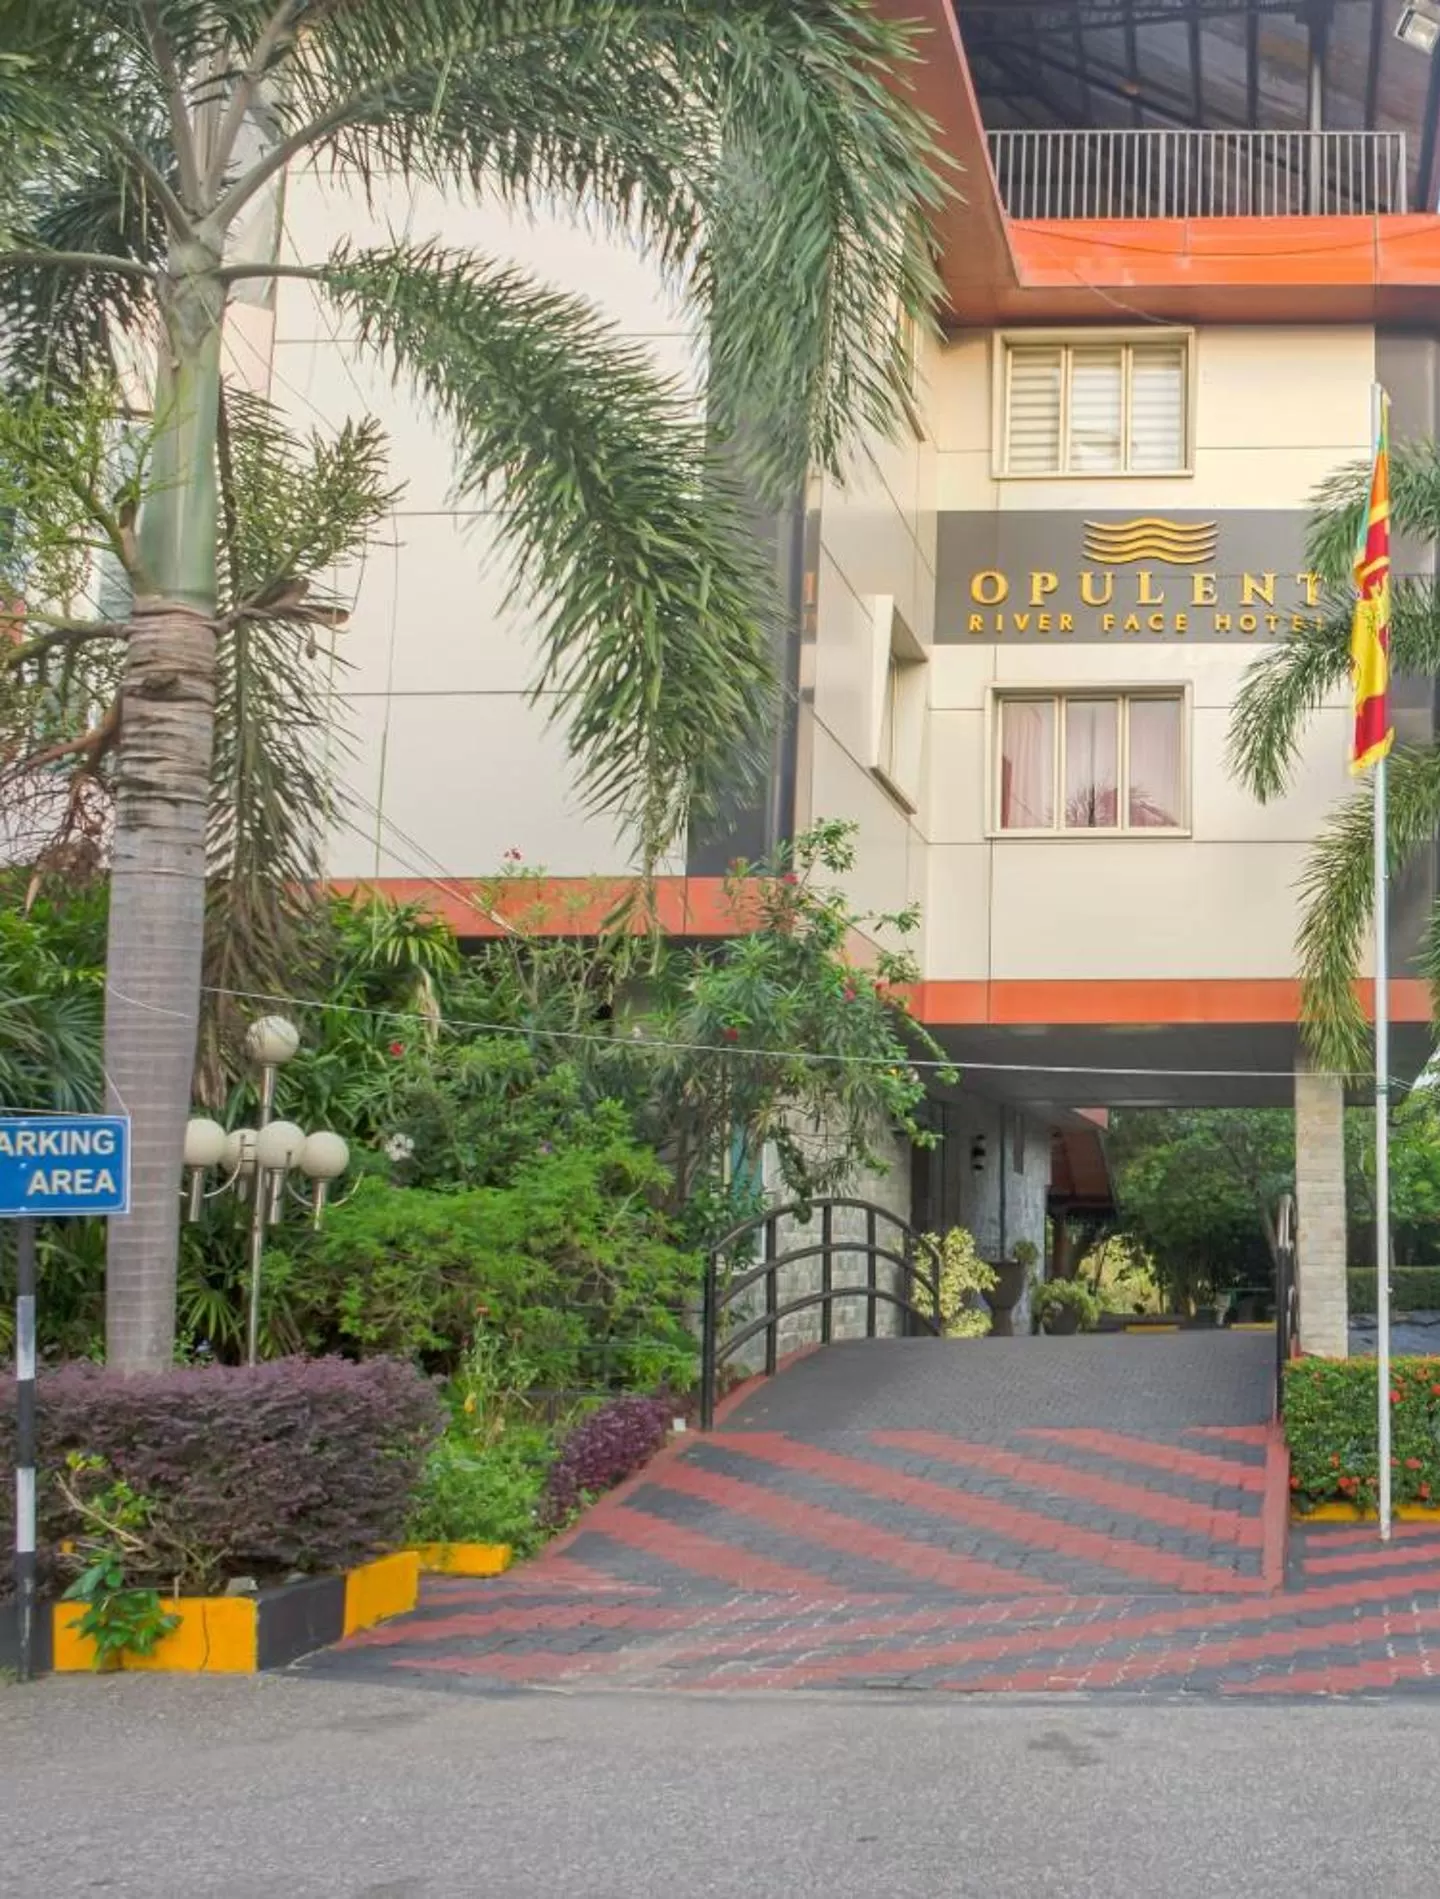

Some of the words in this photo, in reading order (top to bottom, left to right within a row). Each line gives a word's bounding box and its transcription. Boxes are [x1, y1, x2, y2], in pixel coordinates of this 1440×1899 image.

[970, 570, 1326, 607] OPULENT
[968, 613, 1074, 632] RIVER
[1103, 613, 1188, 632] FACE
[26, 1168, 117, 1196] AREA
